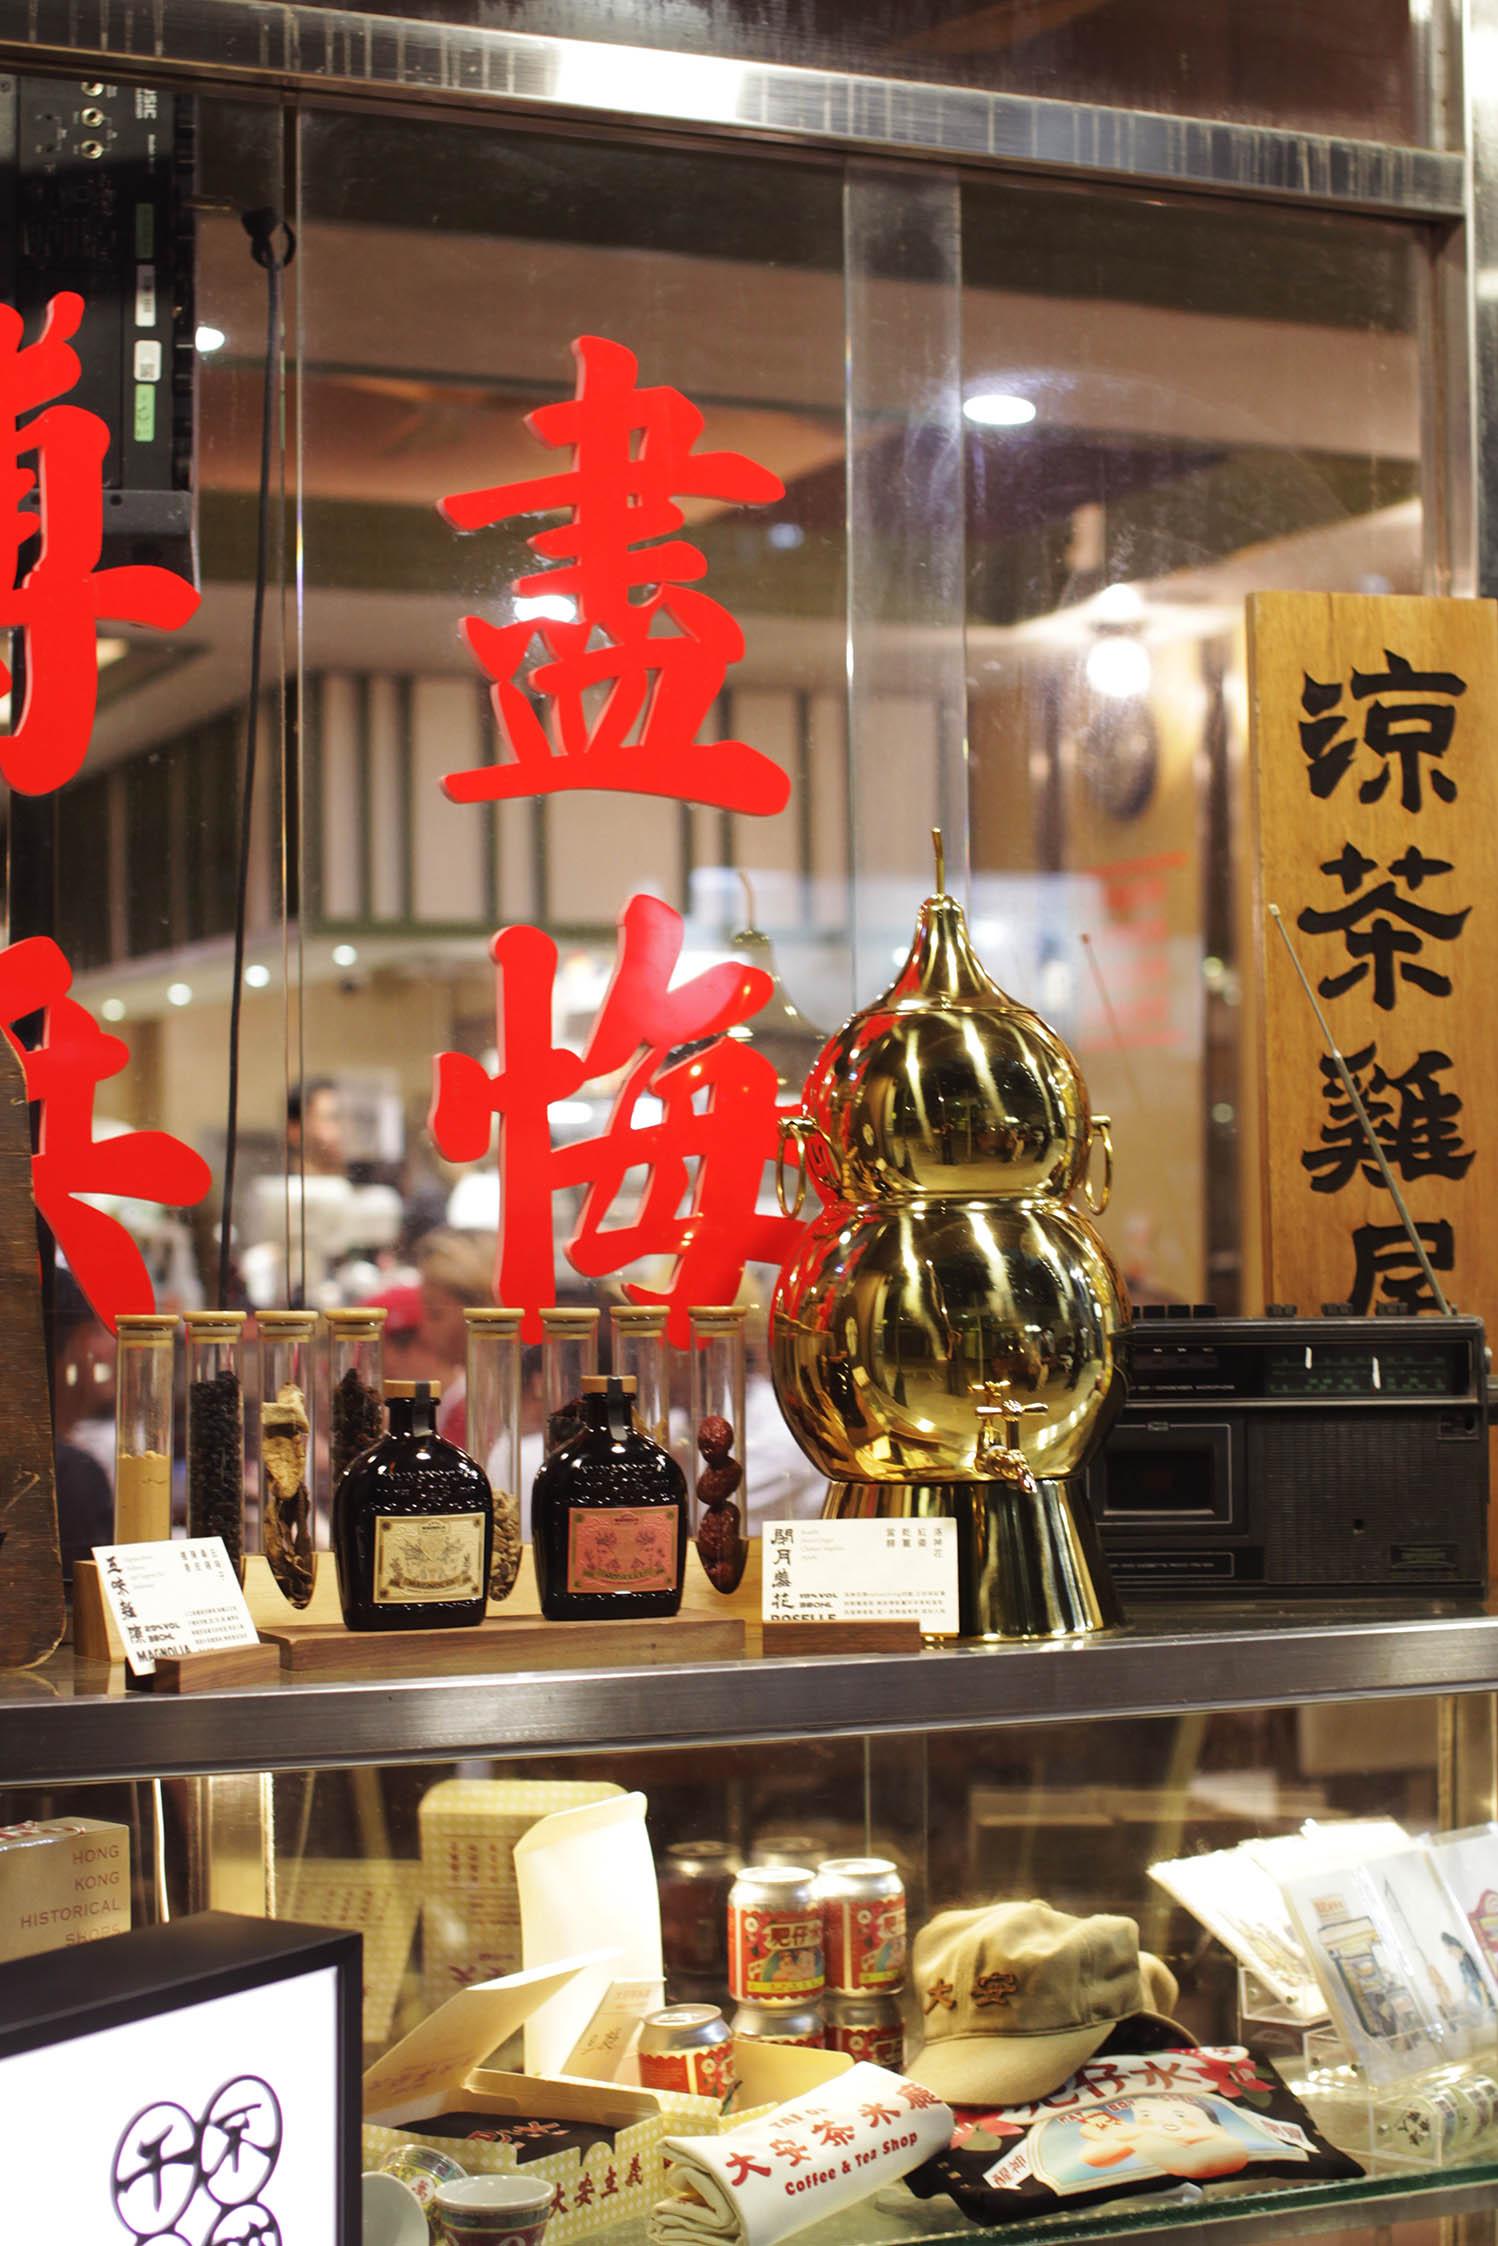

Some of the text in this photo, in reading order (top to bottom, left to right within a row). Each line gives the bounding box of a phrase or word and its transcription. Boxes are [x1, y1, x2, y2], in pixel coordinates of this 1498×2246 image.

[136, 1644, 192, 1662] MAGNOLIA
[72, 1844, 120, 1865] HONG
[74, 1871, 120, 1892] KONG
[20, 1897, 121, 1929] HISTORICAL
[922, 1971, 1018, 2016] 大安
[784, 2131, 918, 2196] Coffee & Tea Shop
